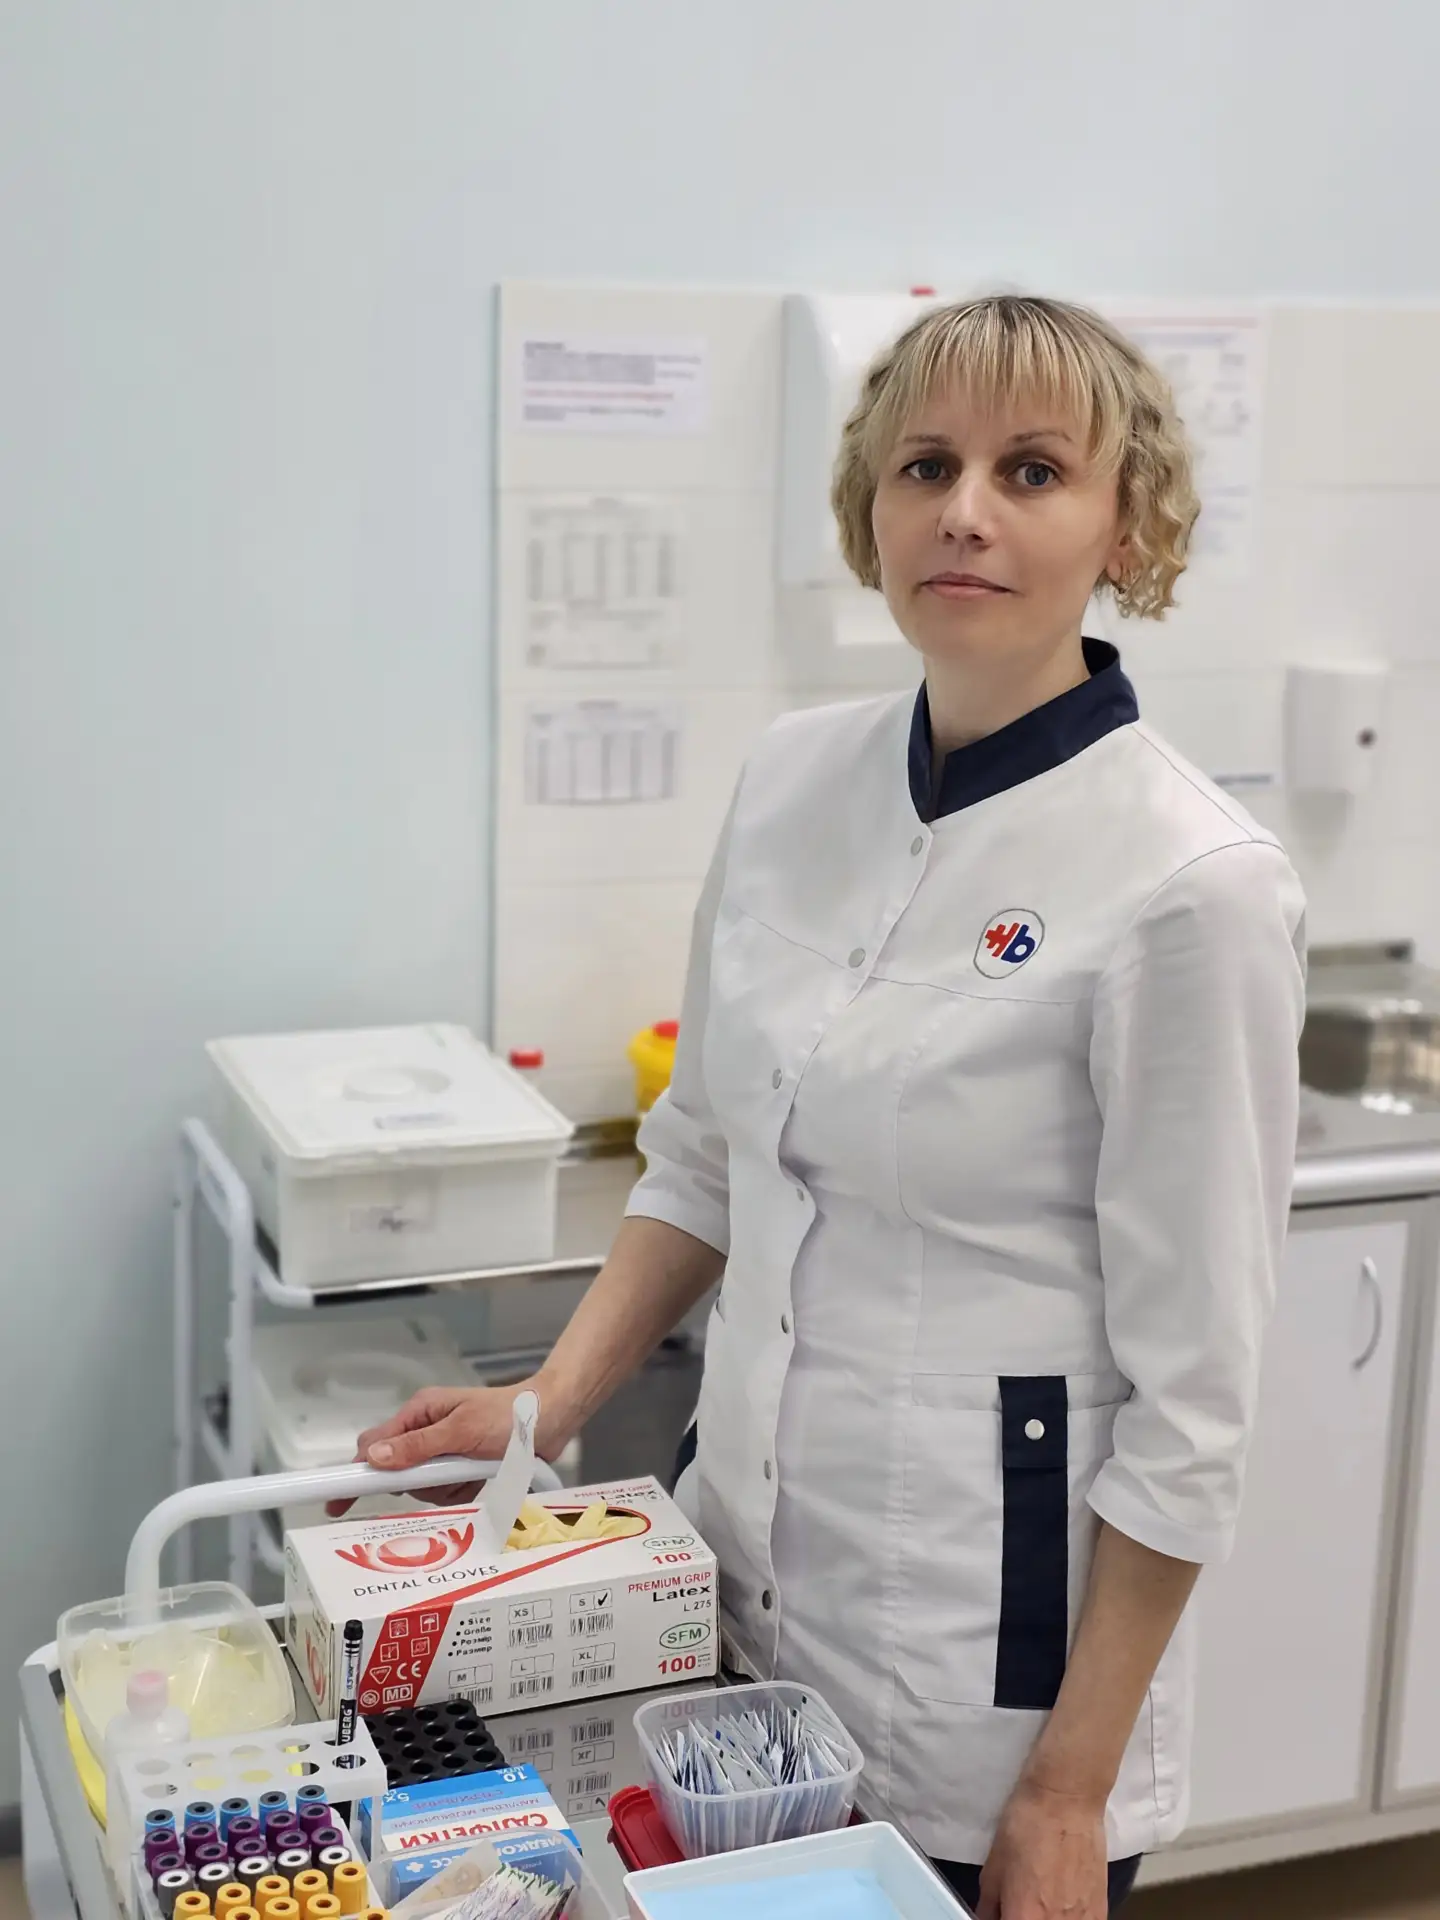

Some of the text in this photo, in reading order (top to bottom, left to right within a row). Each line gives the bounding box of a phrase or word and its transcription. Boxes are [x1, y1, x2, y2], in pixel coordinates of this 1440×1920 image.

[600, 1489, 657, 1501] Latex
[652, 1552, 692, 1564] 100
[353, 1565, 500, 1597] DENTAL GLOVES
[628, 1572, 711, 1593] PREMIUM GRIP
[653, 1585, 711, 1602] Latex
[578, 1598, 586, 1607] S
[683, 1599, 712, 1612] L 275
[513, 1608, 529, 1618] XS
[467, 1616, 491, 1626] Size
[667, 1627, 702, 1644] SFM
[456, 1646, 493, 1657] Размер
[578, 1651, 592, 1660] XL
[520, 1663, 527, 1671] L
[657, 1655, 696, 1675] 100
[456, 1673, 467, 1682] M
[386, 1686, 411, 1701] MD
